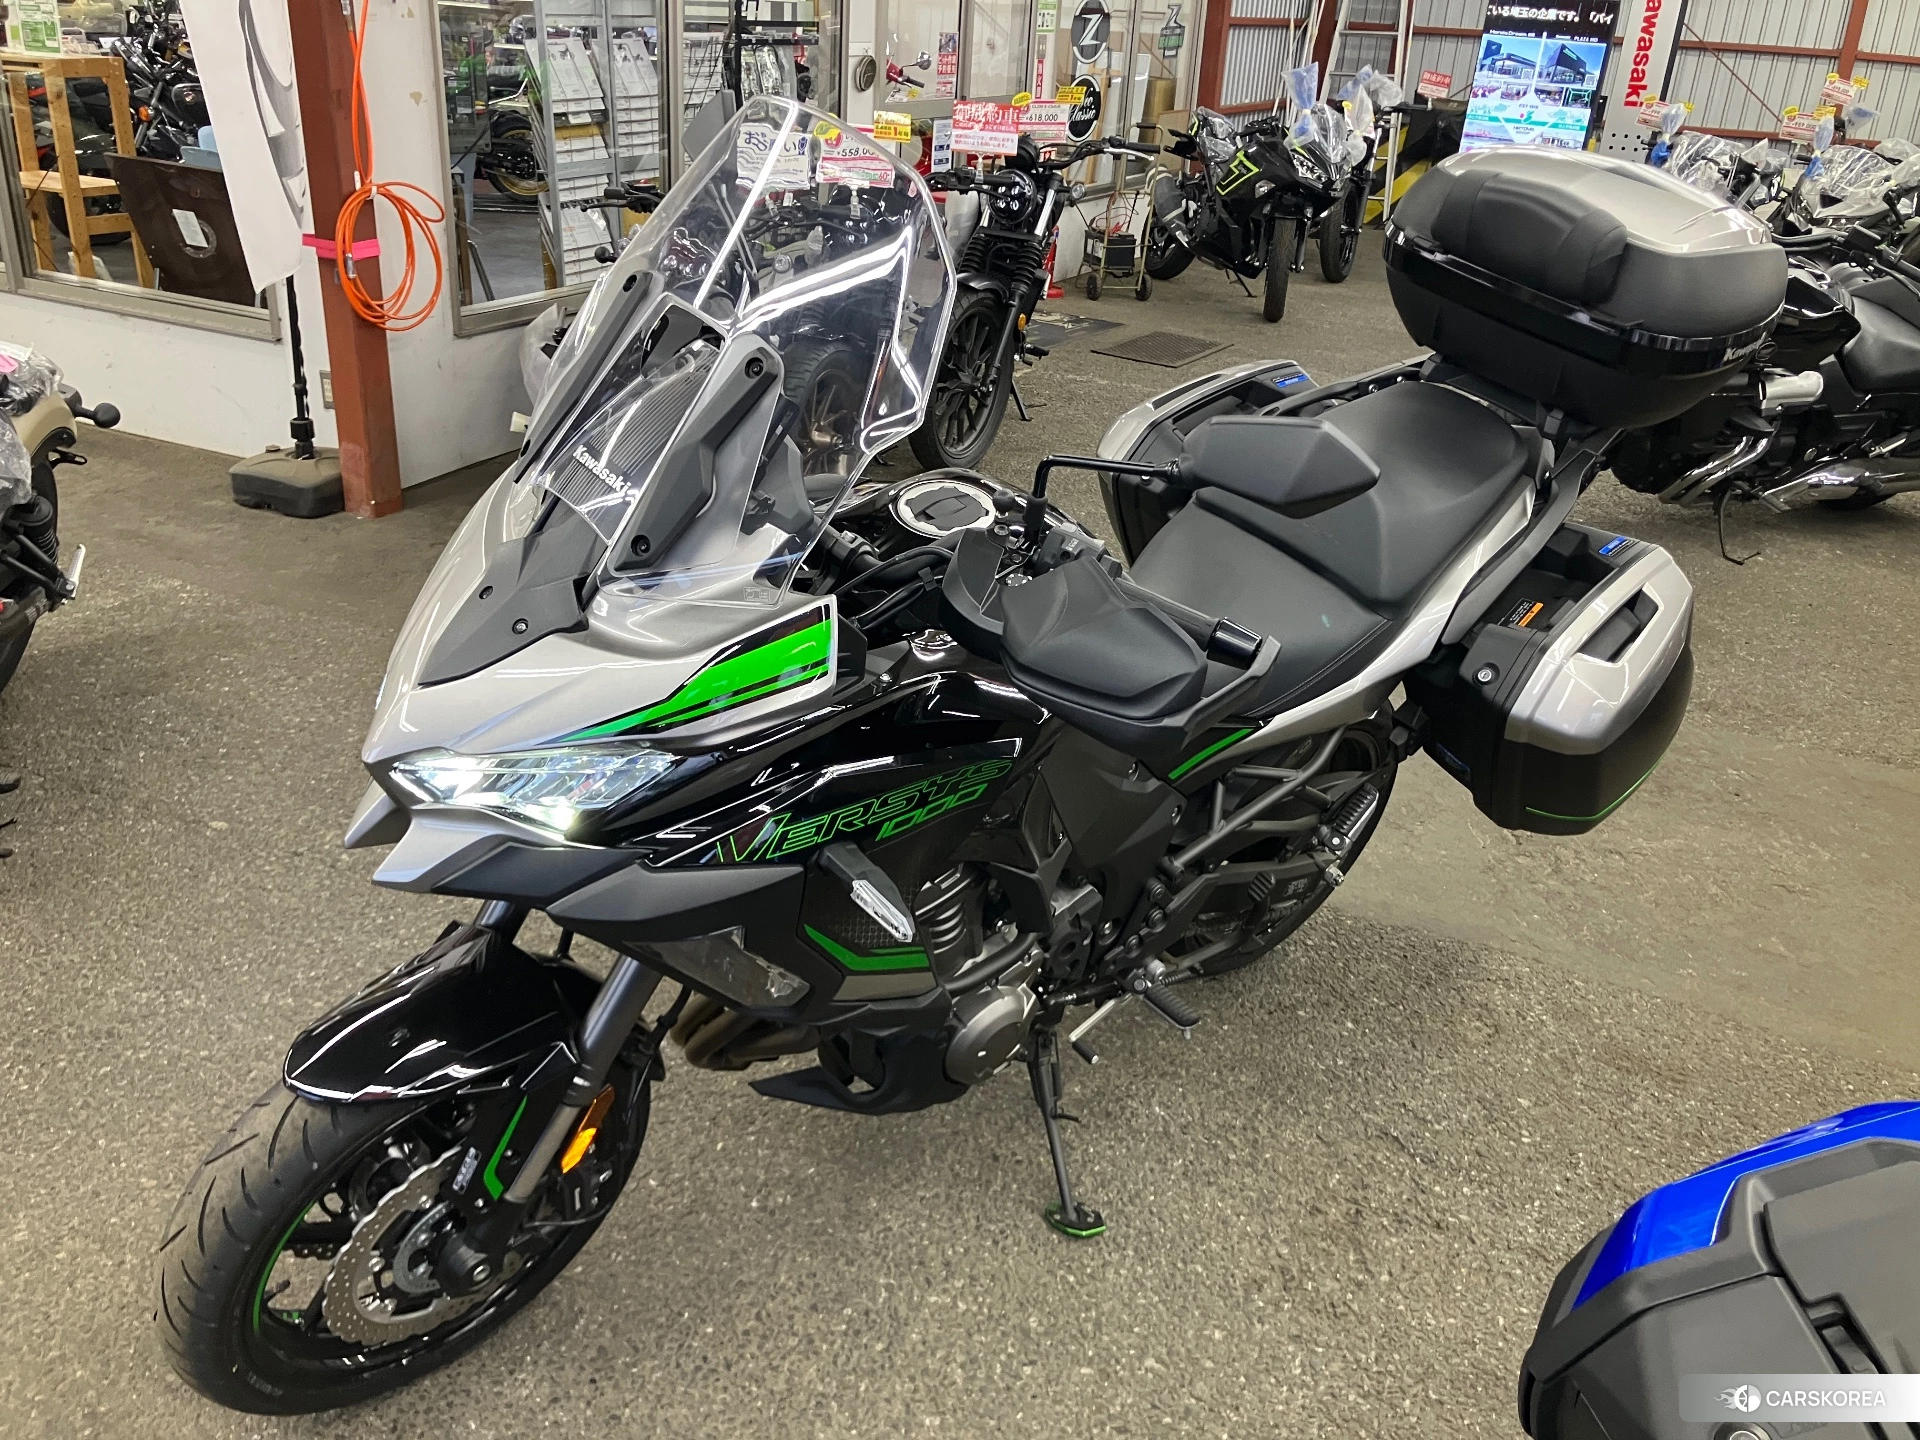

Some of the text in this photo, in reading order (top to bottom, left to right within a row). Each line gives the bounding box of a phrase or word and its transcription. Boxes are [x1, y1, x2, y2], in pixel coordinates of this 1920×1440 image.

[572, 444, 632, 494] Kawasaki
[716, 759, 1013, 862] VERSYS
[875, 783, 988, 842] 1000
